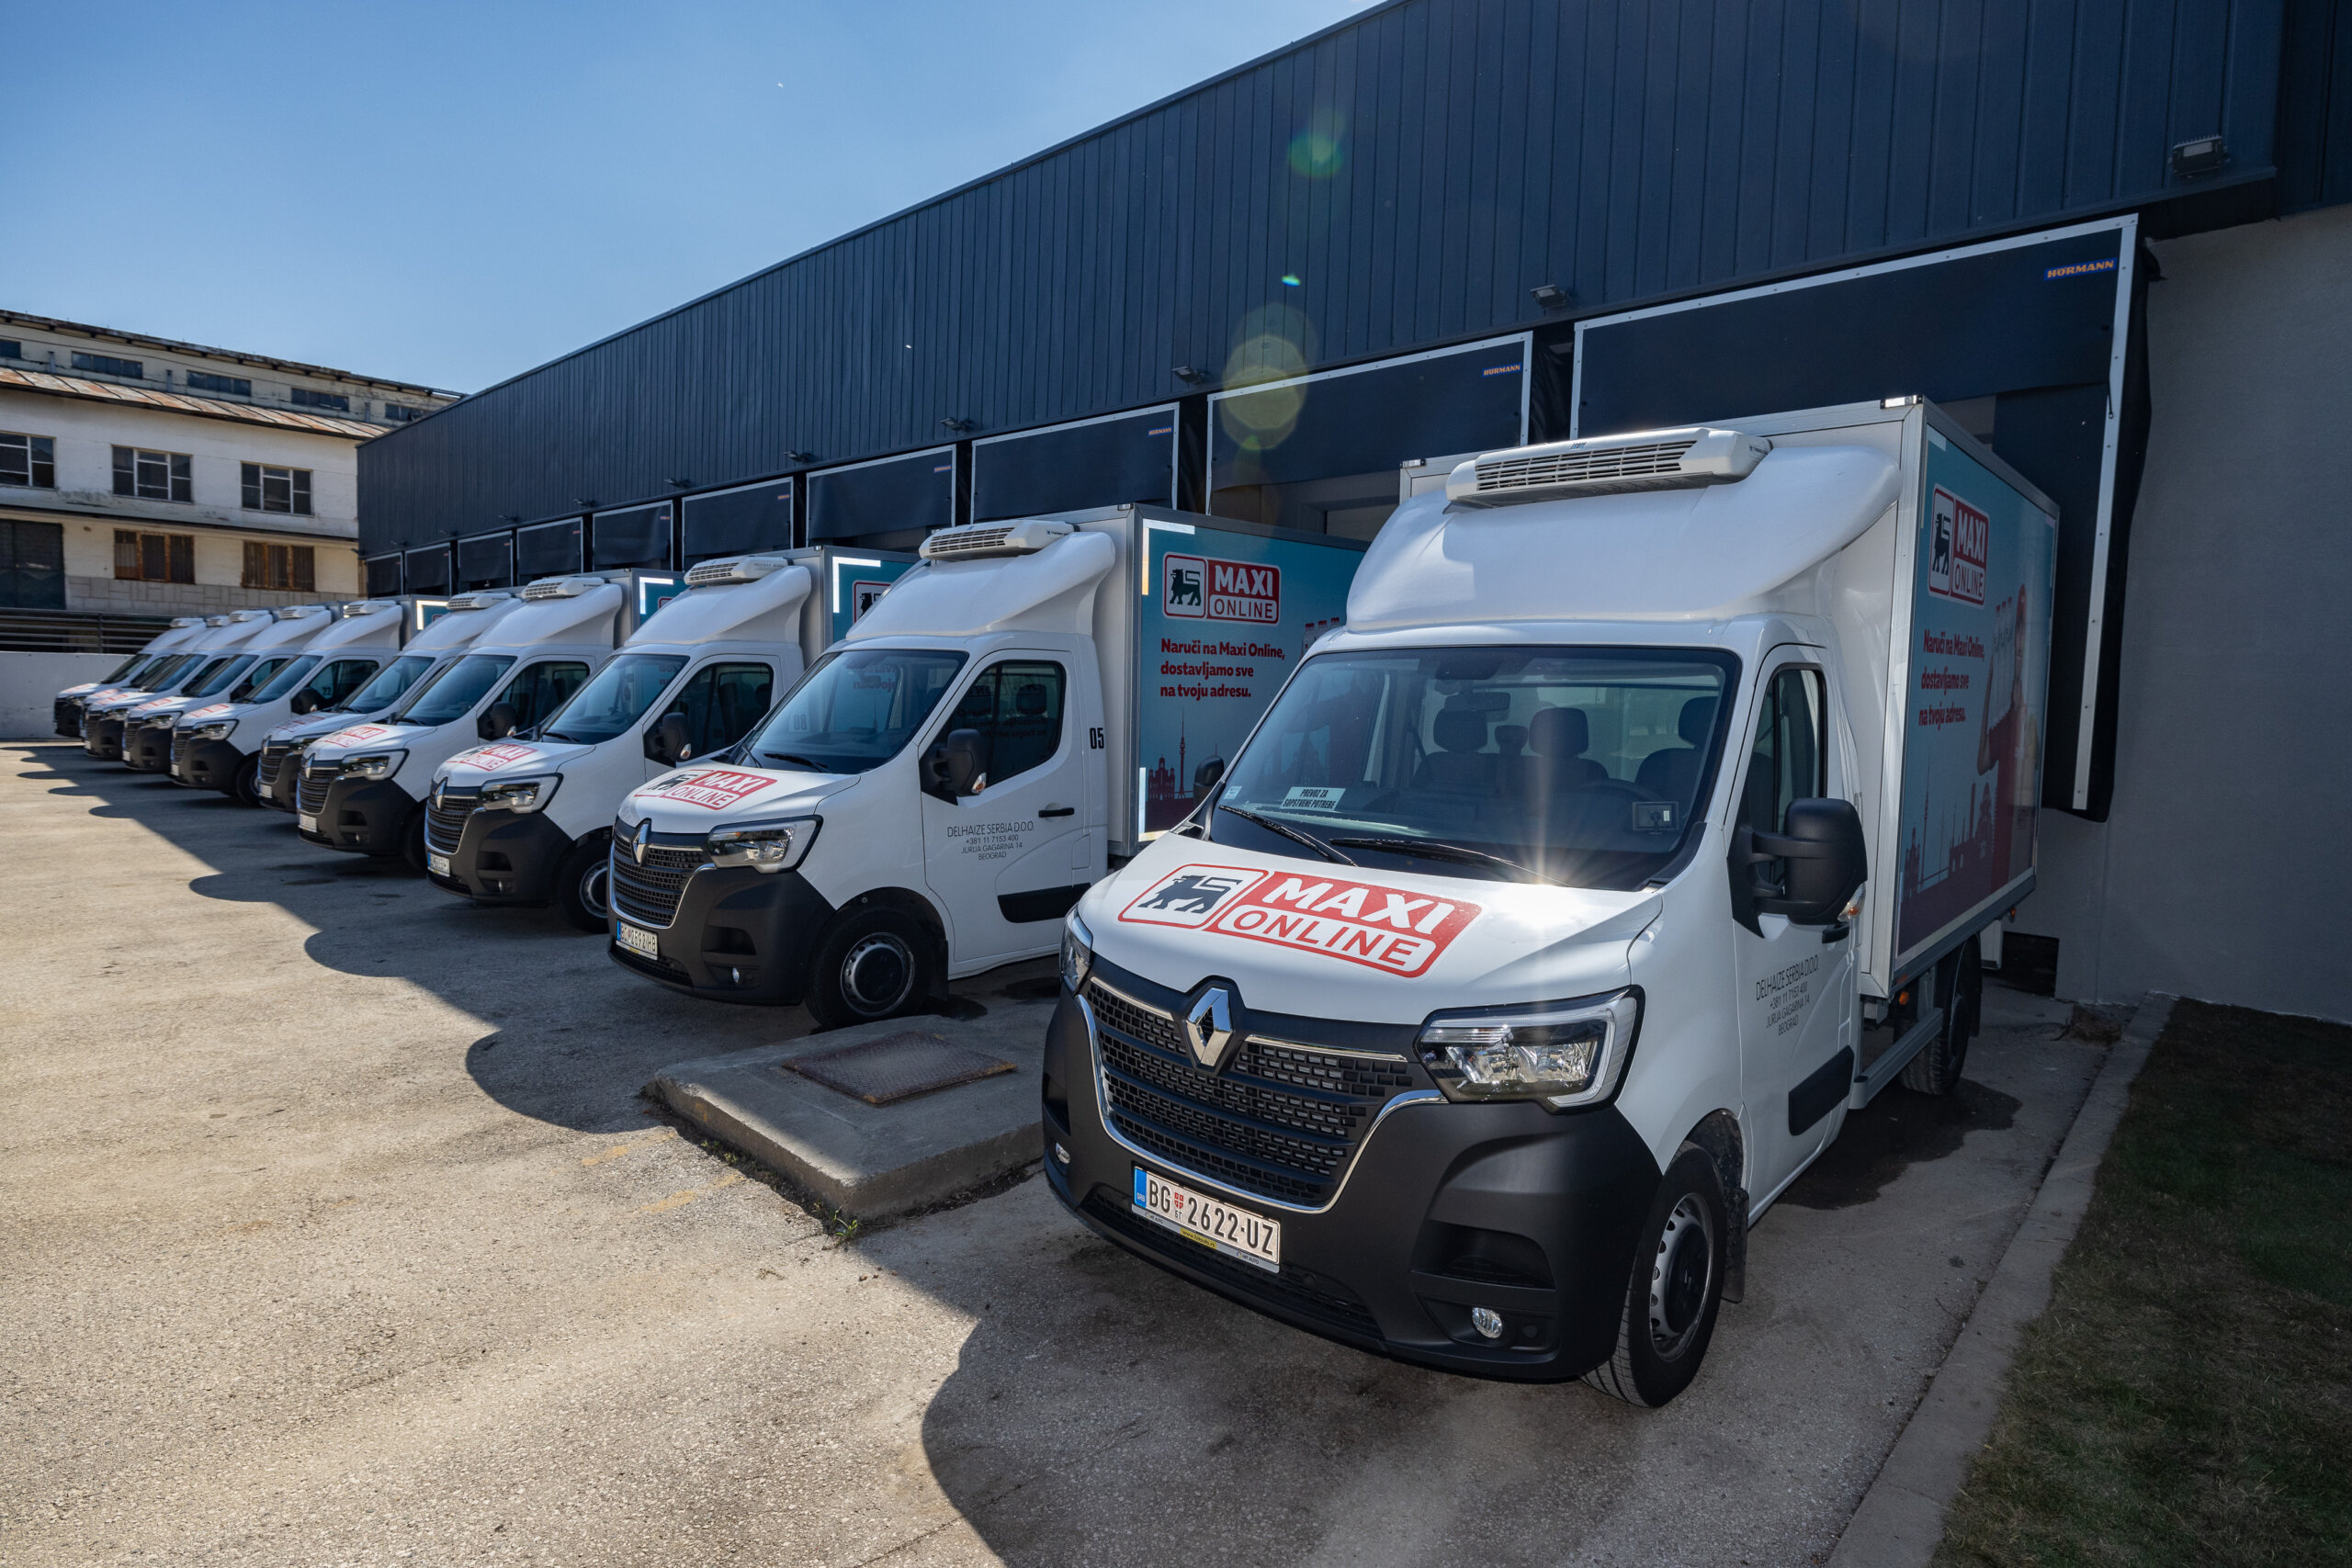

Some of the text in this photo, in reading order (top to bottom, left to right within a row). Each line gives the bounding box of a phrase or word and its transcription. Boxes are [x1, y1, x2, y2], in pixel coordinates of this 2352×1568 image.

[1956, 509, 1986, 563] MAXI
[1215, 565, 1273, 596] MAXI
[1954, 563, 1984, 597] ONLINE
[1214, 598, 1273, 619] ONLINE
[1160, 637, 1285, 660] Naruči na Maxi Online,
[1160, 660, 1254, 680] dostavljamo sve
[1159, 682, 1251, 701] na tvoju adresu.
[1090, 728, 1104, 749] 05
[695, 772, 767, 794] MAXI
[671, 786, 733, 806] ONLINE
[947, 824, 986, 838] DELHAIZE
[987, 822, 1013, 835] SERBIA
[966, 837, 981, 845] +381
[982, 843, 1014, 852] GAGARINA
[978, 851, 1007, 861] BEOGRAD
[1261, 877, 1456, 935] MAXI
[1233, 910, 1421, 966] ONLINE
[1756, 970, 1785, 1001] DELHAIZE
[1785, 961, 1804, 987] SERBIA
[1149, 1179, 1170, 1213] BG
